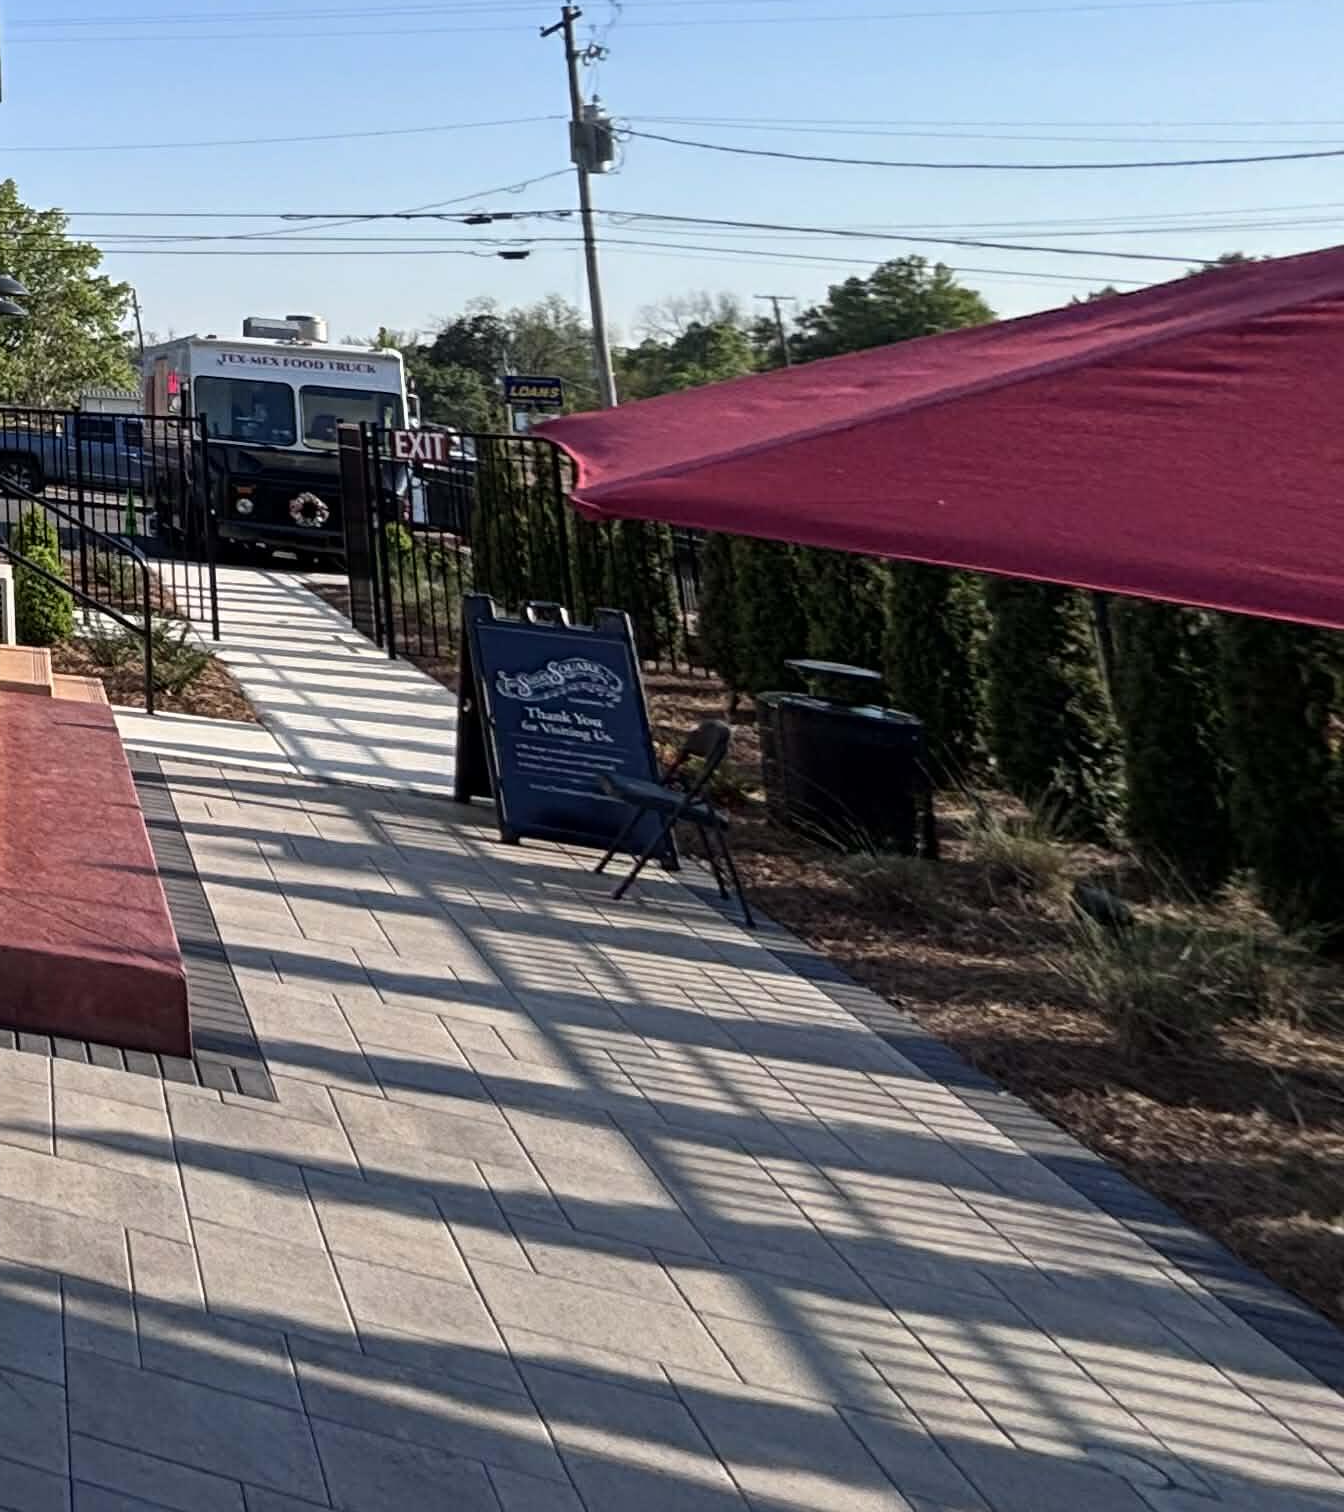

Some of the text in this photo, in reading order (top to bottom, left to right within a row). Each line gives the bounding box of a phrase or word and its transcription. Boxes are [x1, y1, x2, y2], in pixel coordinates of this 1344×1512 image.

[283, 358, 325, 371] FOOD
[328, 361, 376, 375] TRUCK
[393, 430, 446, 461] EXIT
[524, 705, 603, 729] Thank You
